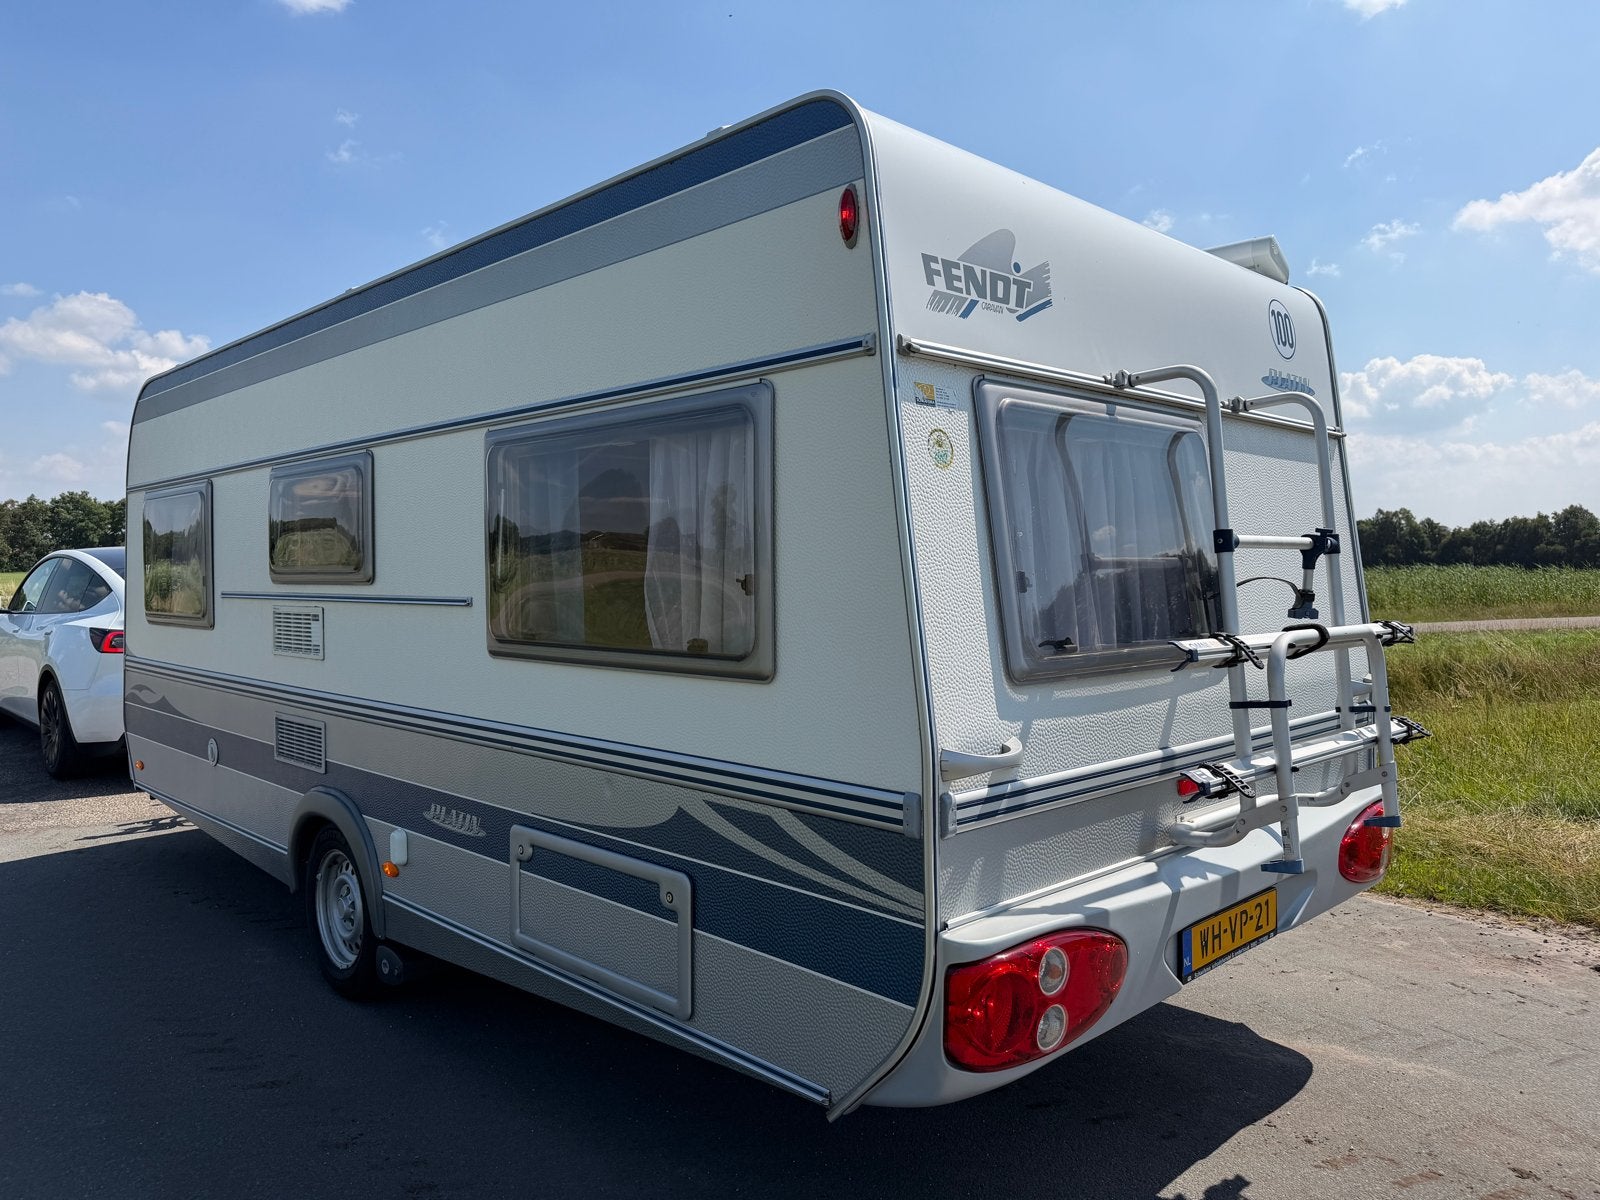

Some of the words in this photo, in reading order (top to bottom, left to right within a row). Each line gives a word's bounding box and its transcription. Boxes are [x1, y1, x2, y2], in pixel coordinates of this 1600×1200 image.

[920, 252, 1032, 309] FENDT
[1270, 309, 1294, 349] 100
[1200, 898, 1270, 959] WH-VP-21
[1183, 956, 1191, 967] NL
